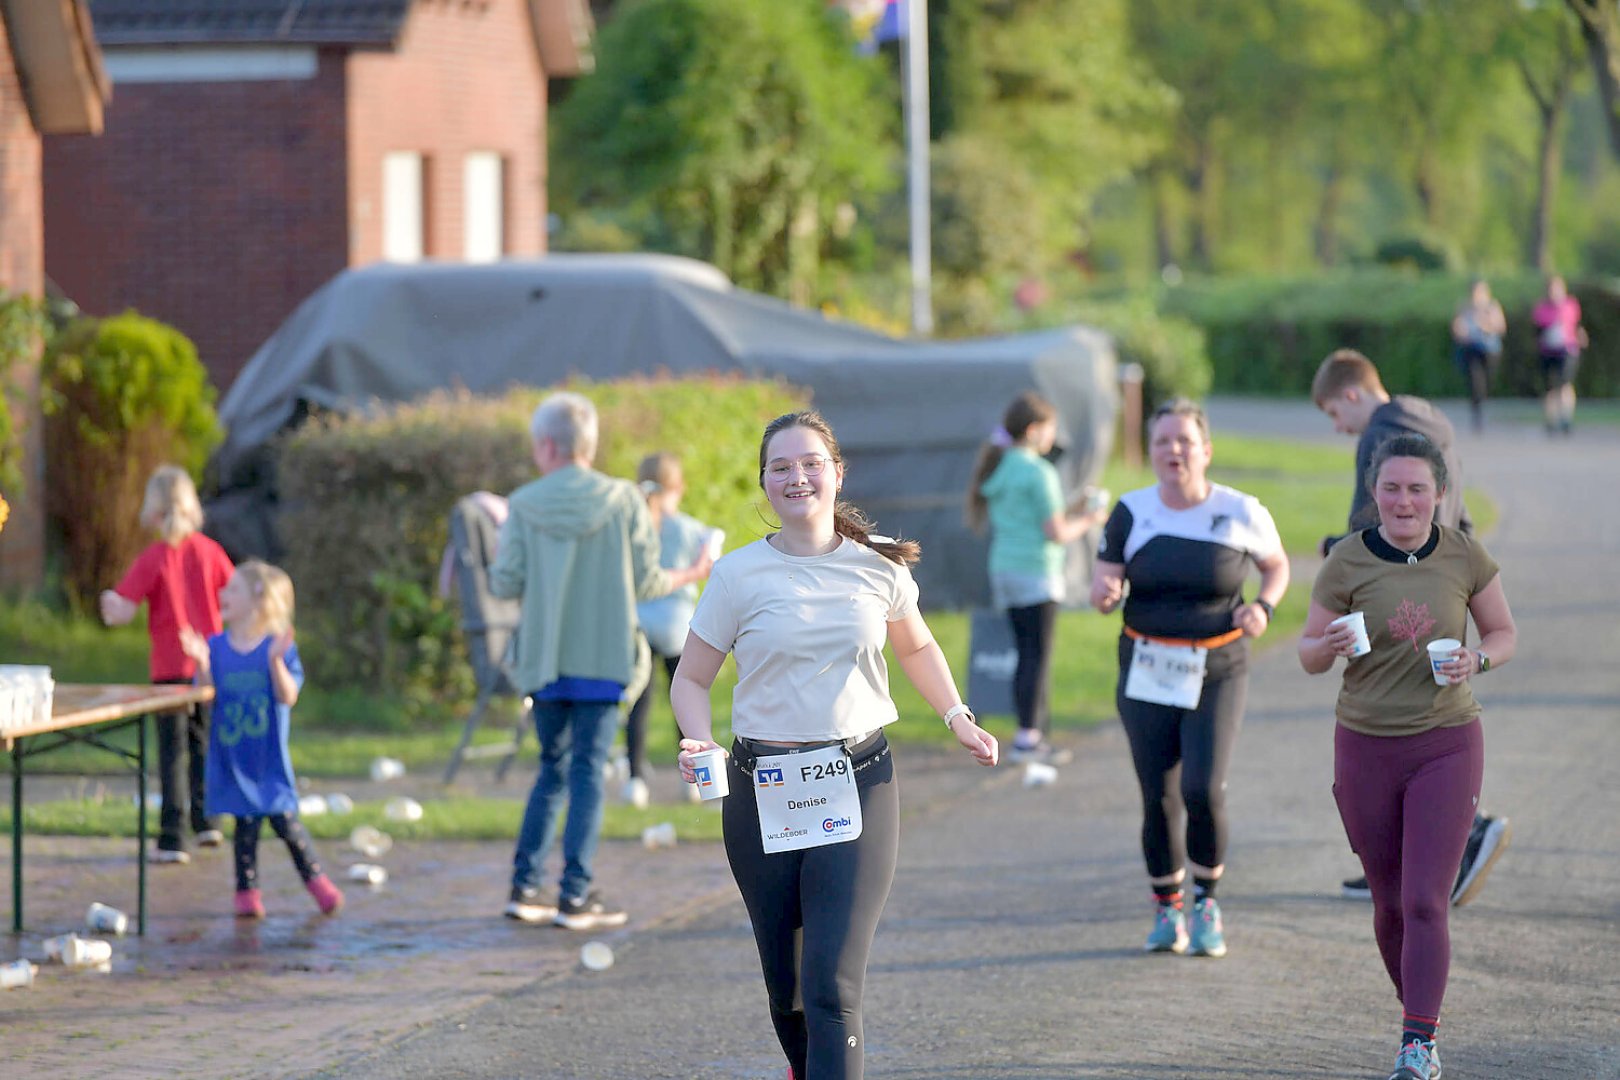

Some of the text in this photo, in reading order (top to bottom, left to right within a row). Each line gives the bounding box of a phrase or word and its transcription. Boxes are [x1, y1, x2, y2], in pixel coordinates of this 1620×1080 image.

[218, 692, 269, 747] 33
[800, 759, 847, 782] F249
[787, 797, 827, 810] Denise
[822, 816, 851, 833] Combi
[767, 829, 808, 840] WILDEBOER
